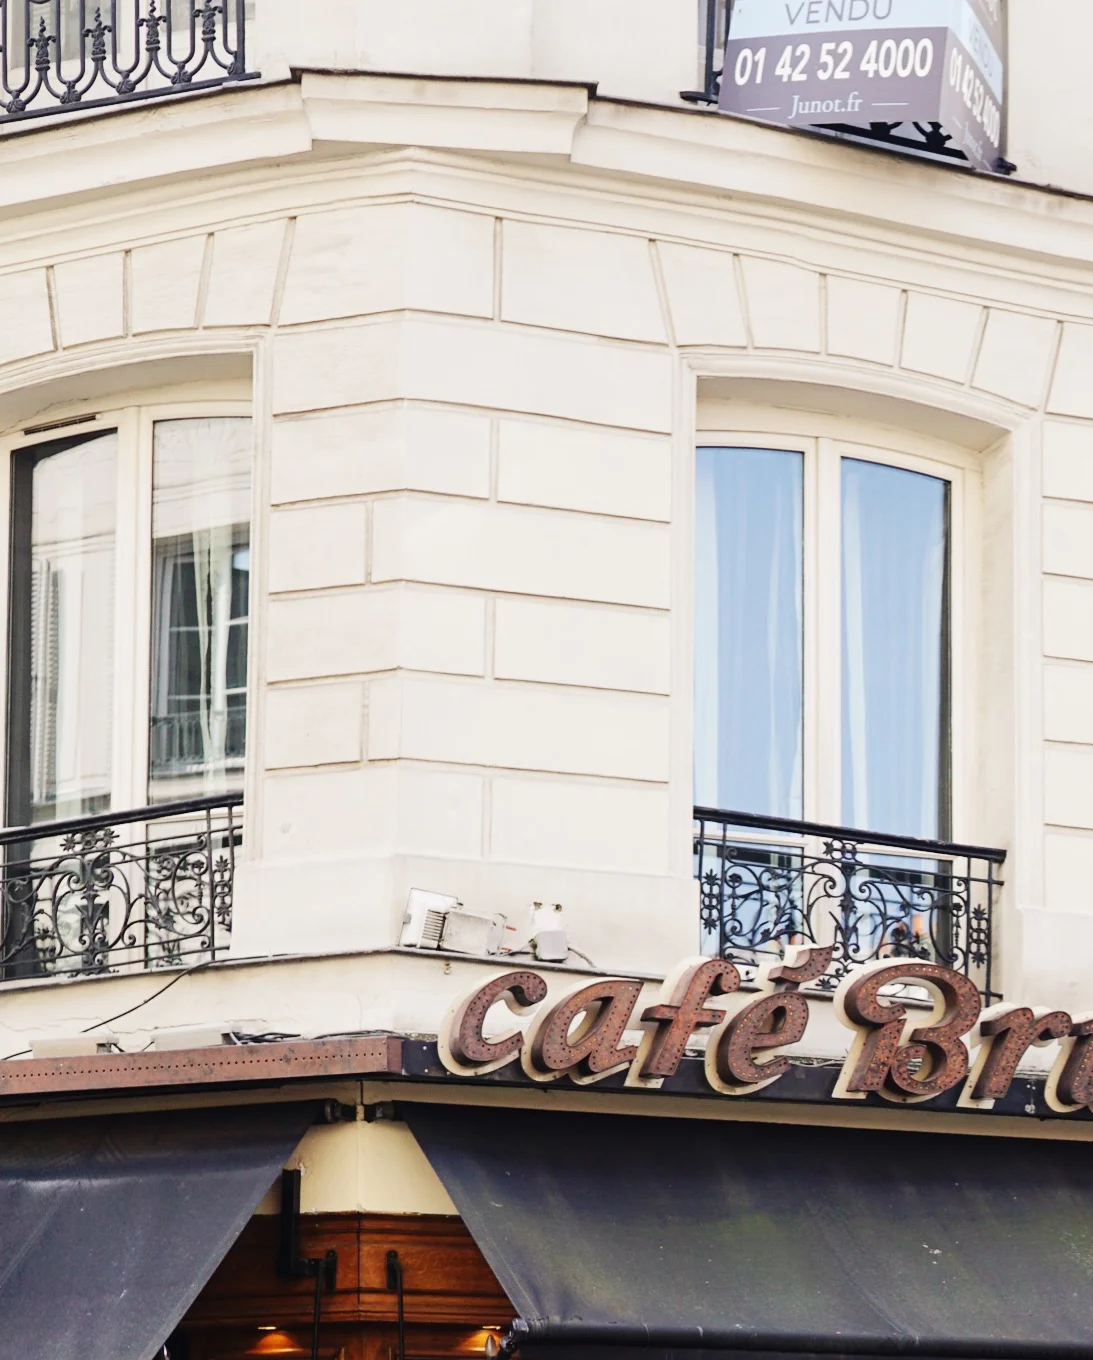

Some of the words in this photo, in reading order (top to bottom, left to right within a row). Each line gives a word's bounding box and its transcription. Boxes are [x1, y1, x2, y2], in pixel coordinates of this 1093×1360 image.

[785, 0, 892, 25] VENDU
[734, 47, 766, 85] 01
[775, 43, 811, 82] 42
[817, 41, 853, 80] 52
[860, 38, 934, 78] 4000
[950, 47, 963, 92] 01
[788, 91, 863, 118] Junot.fr
[438, 943, 834, 1097] café
